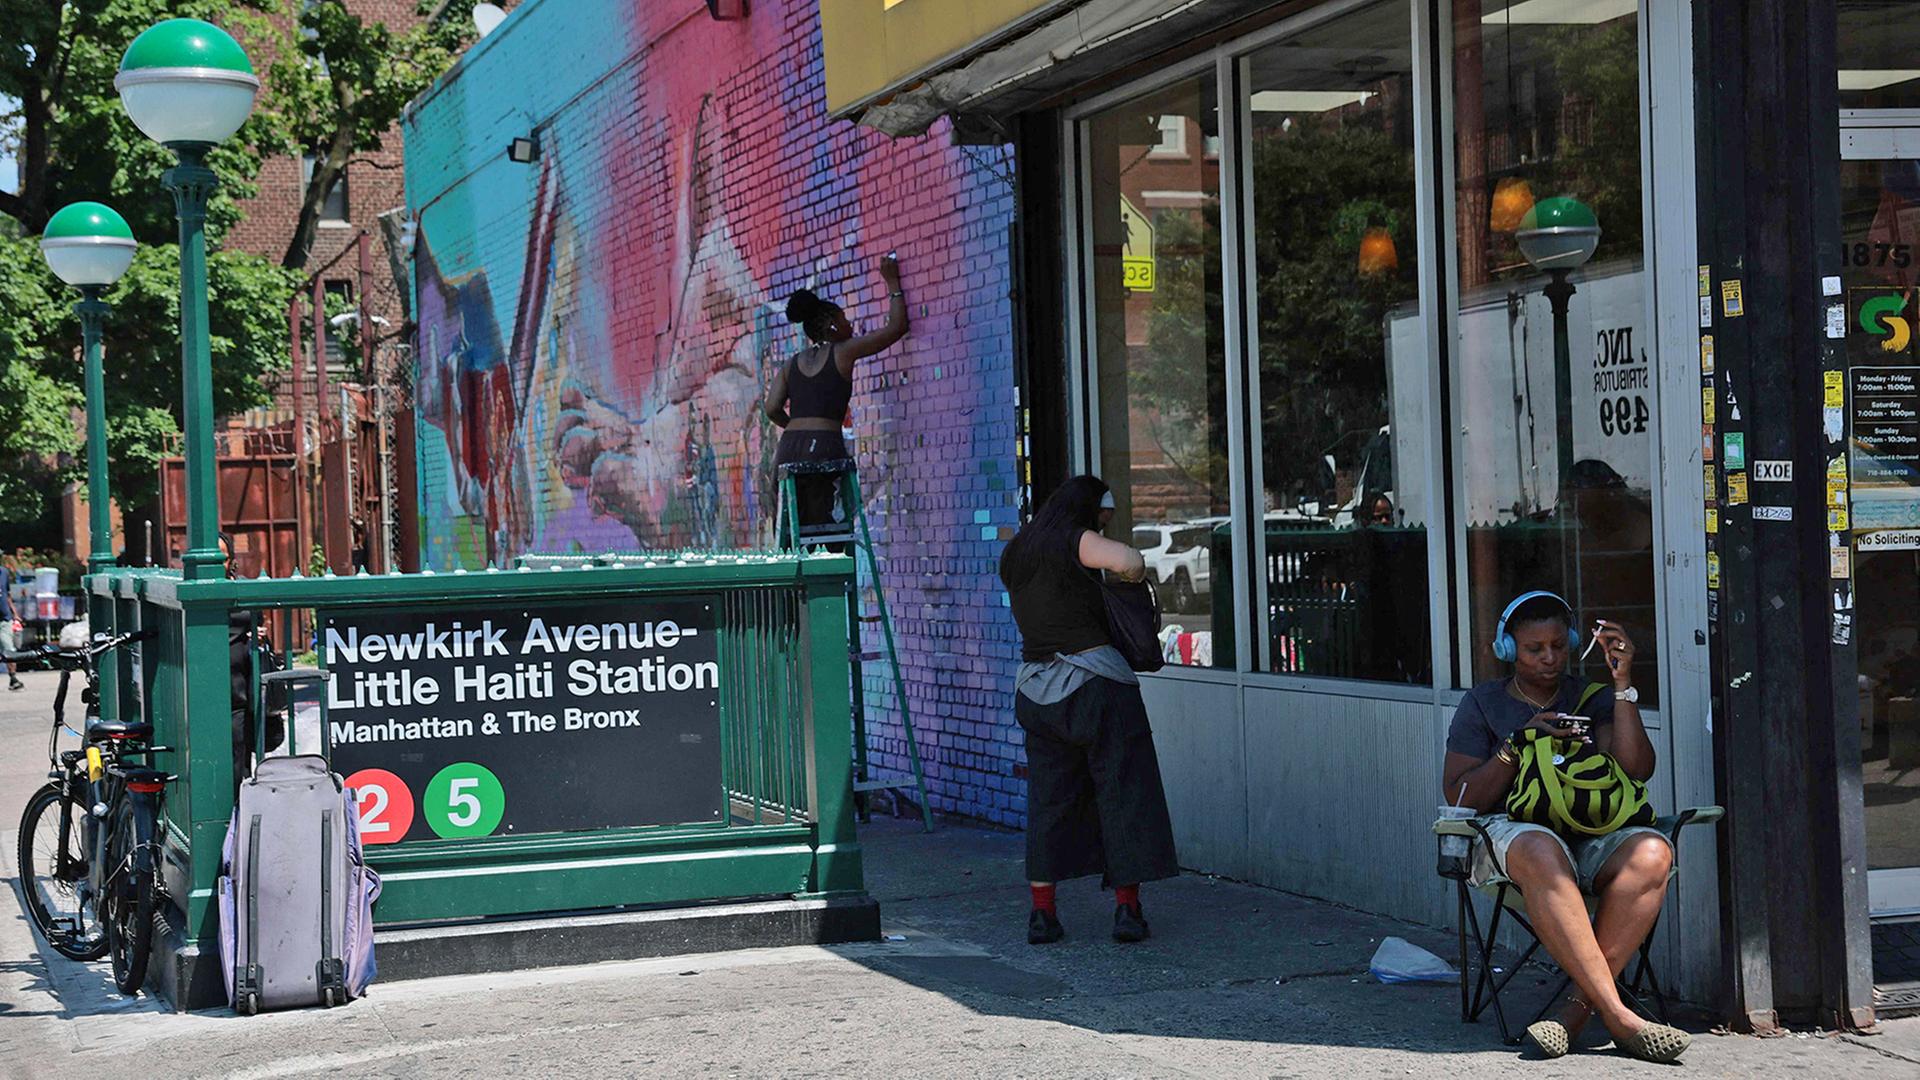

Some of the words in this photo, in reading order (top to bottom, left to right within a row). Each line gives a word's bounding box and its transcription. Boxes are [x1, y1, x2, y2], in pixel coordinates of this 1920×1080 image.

[1842, 243, 1911, 268] 1875
[1860, 375, 1887, 383] Monday
[1890, 375, 1912, 383] Friday
[1887, 383, 1915, 391] 11:00pm
[1755, 464, 1790, 479] EXOE
[1859, 536, 1872, 545] No
[1875, 532, 1920, 546] Soliciting
[326, 620, 509, 664] Newkirk
[521, 618, 698, 655] Avenue-
[328, 669, 440, 709] Little
[454, 661, 554, 702] Haiti
[567, 656, 719, 696] Station
[332, 717, 473, 744] Manhattan
[481, 713, 501, 735] &
[507, 710, 557, 733] The
[565, 707, 640, 730] Bronx
[359, 784, 390, 834] 2
[447, 777, 481, 828] 5
